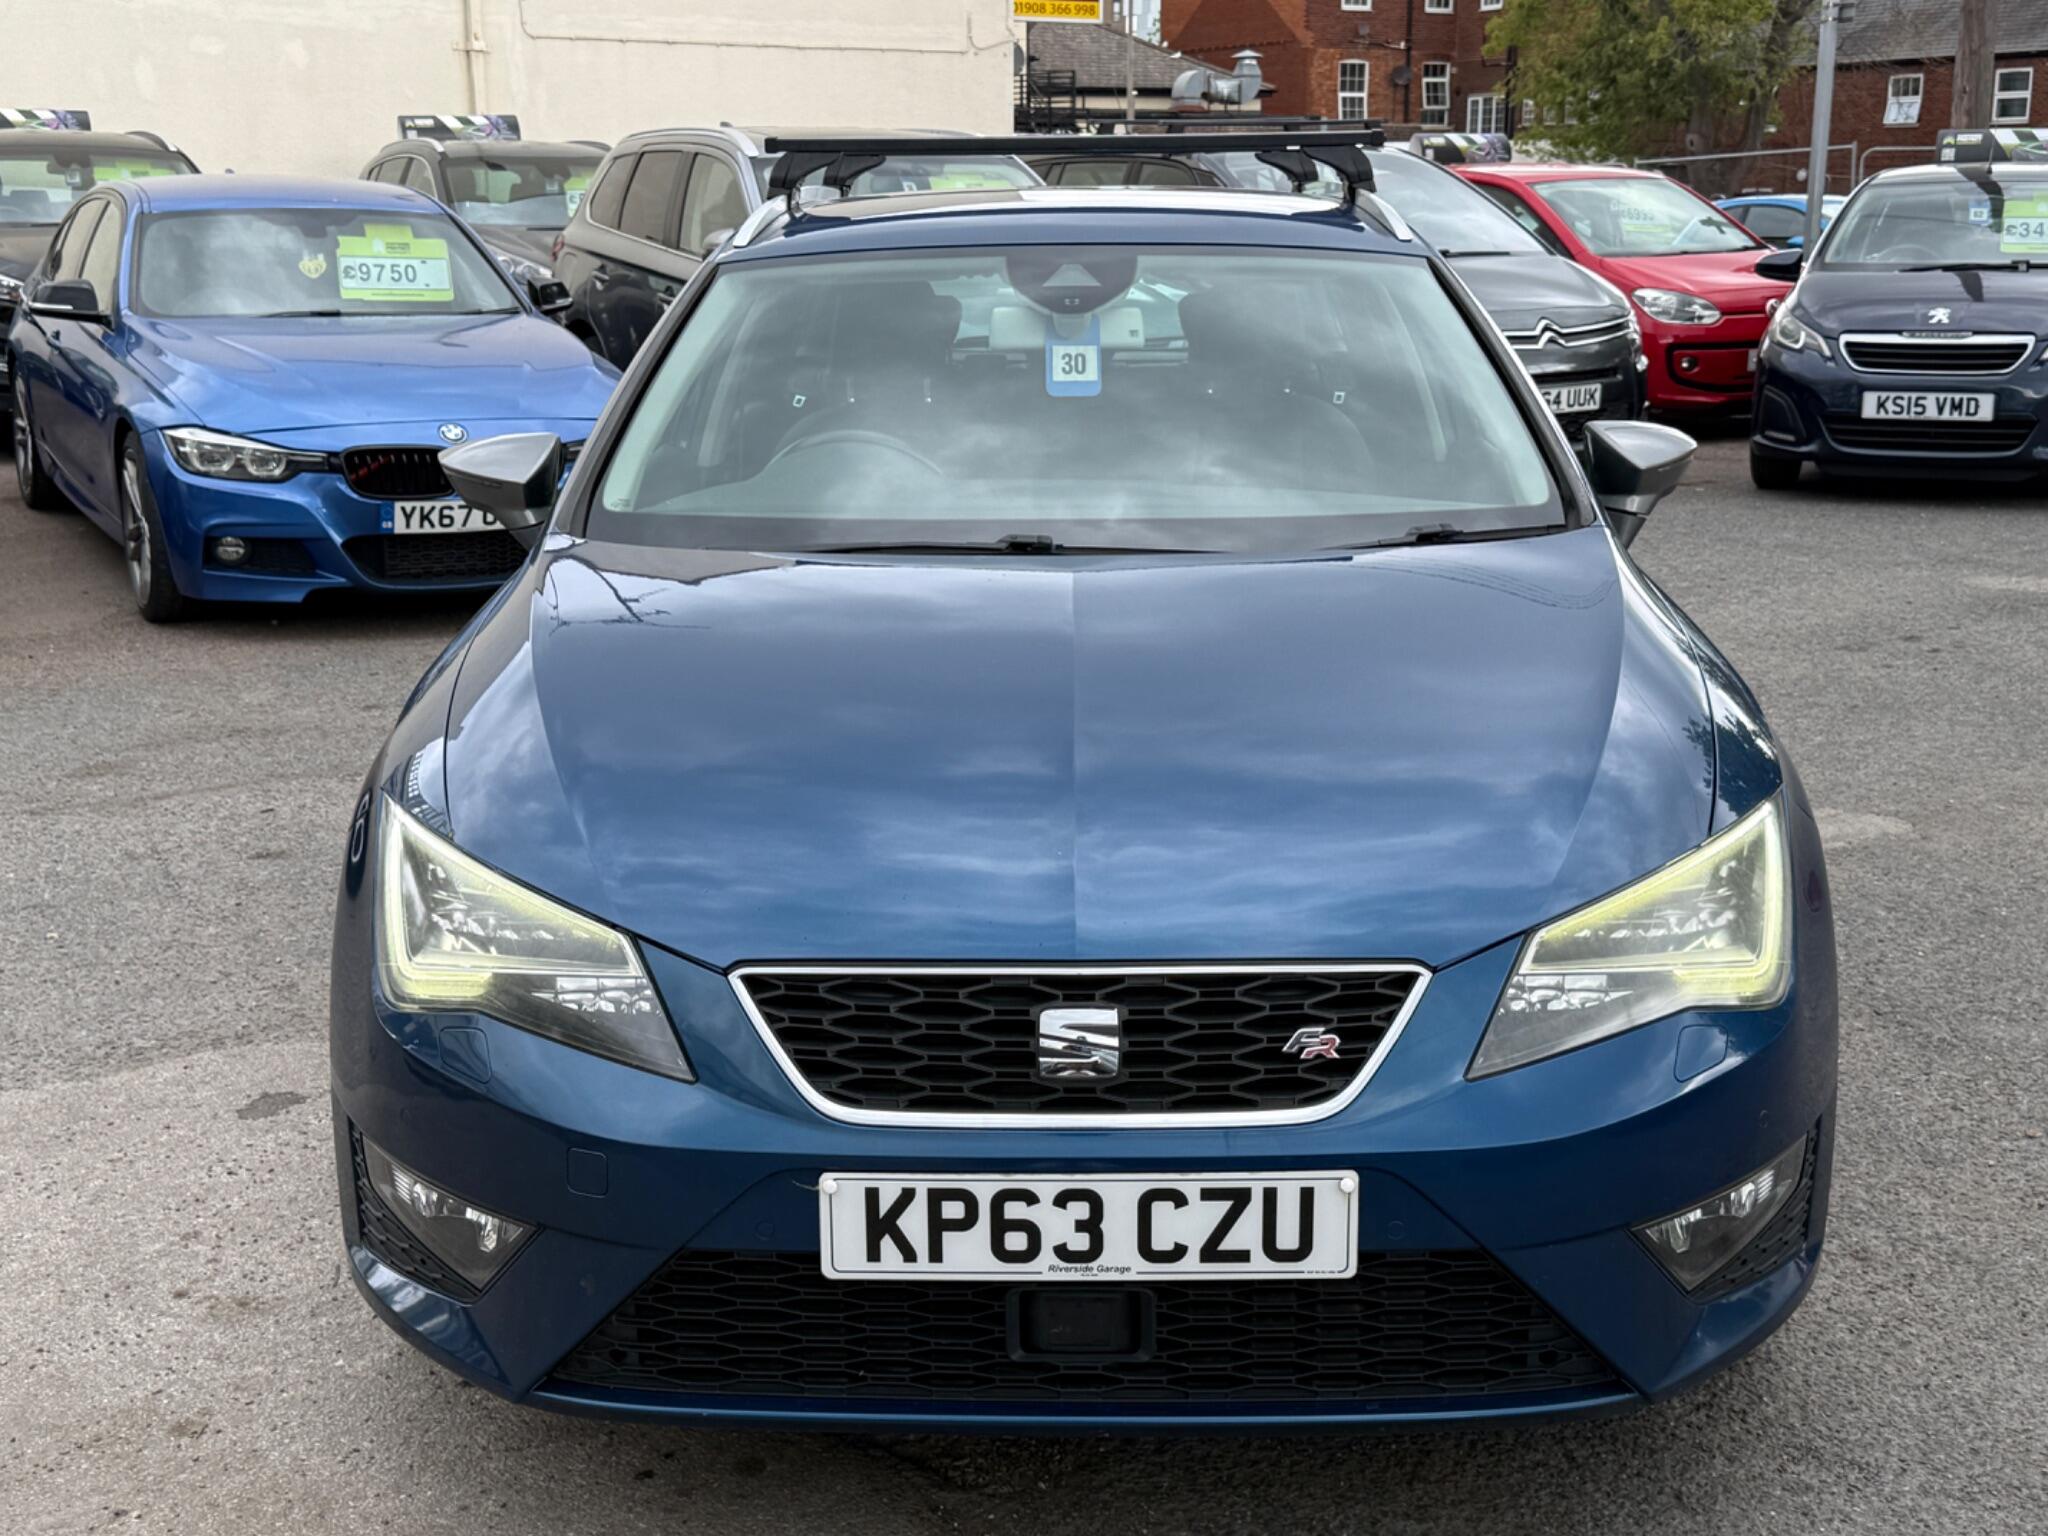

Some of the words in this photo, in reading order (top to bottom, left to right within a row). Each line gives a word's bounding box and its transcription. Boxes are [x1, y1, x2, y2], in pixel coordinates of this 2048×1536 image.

[1051, 3, 1072, 15] 366
[1074, 4, 1096, 16] 998
[342, 262, 417, 284] £9750
[1061, 352, 1087, 375] 30
[1567, 387, 1598, 408] UUK
[1875, 395, 1928, 416] KS15
[1935, 397, 1980, 417] VMD
[400, 505, 474, 530] YK67
[1281, 1027, 1341, 1060] FR
[864, 1186, 1106, 1264] KP63
[1136, 1186, 1316, 1264] CZU
[1047, 1264, 1094, 1273] Riverside
[1096, 1264, 1132, 1275] Garage
